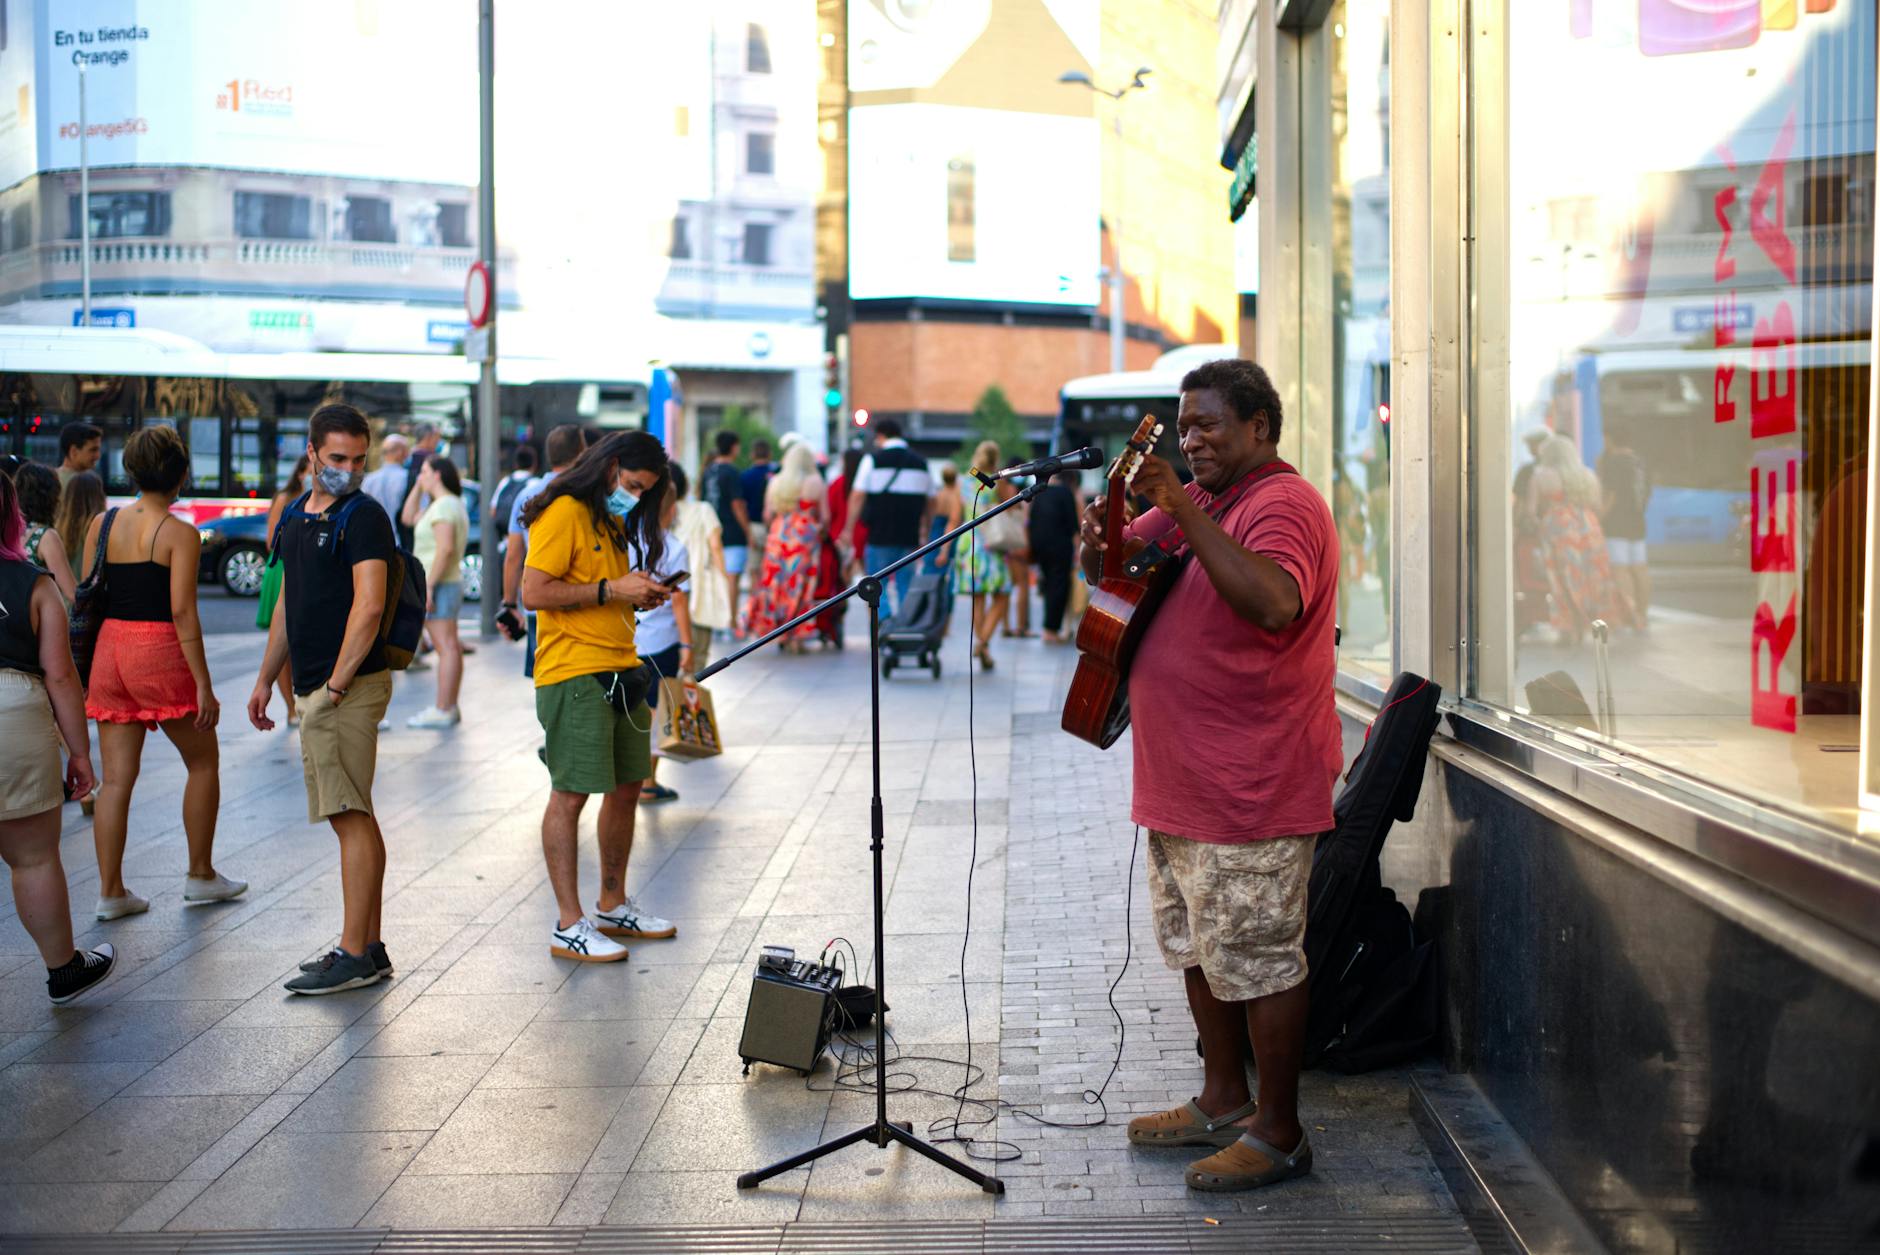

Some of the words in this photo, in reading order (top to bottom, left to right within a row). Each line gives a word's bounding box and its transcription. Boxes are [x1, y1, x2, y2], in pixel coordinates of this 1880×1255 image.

[54, 30, 74, 46] En
[79, 30, 94, 43] tu
[98, 25, 149, 41] tienda
